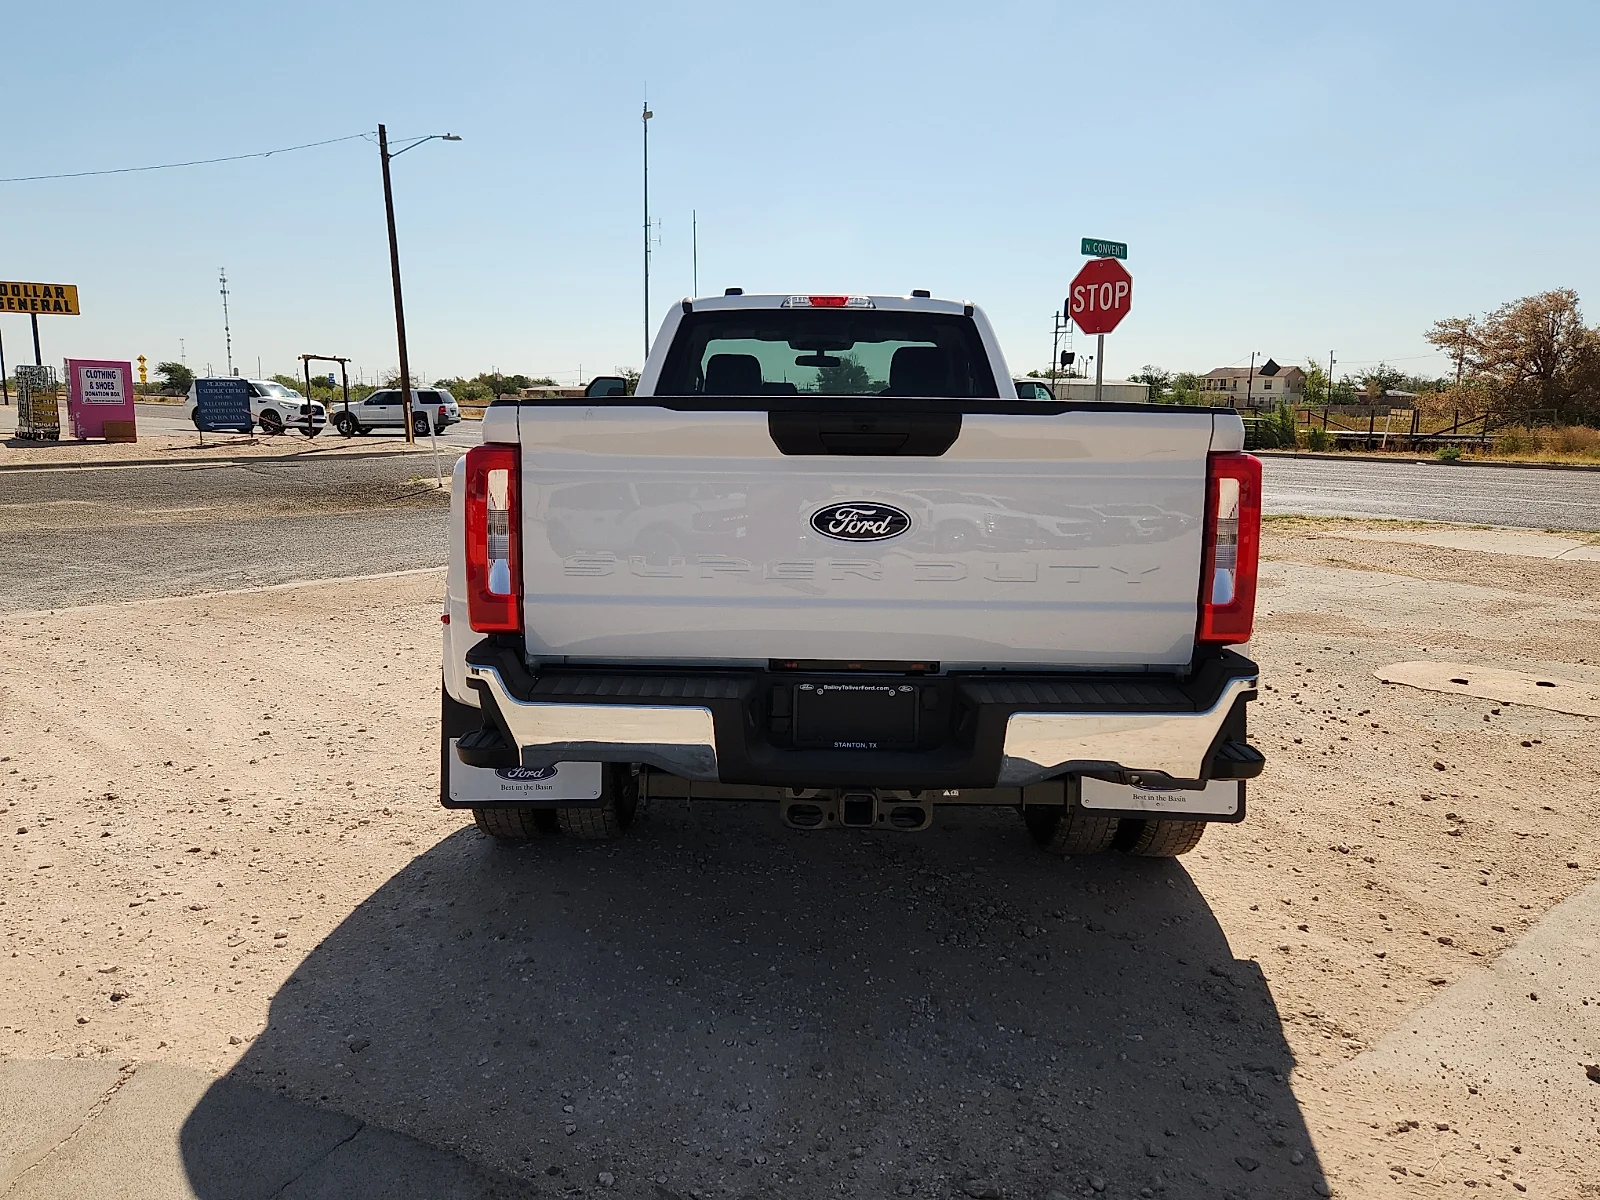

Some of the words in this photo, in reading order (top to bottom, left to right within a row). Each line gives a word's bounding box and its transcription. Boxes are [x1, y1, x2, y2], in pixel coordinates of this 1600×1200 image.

[1085, 244, 1091, 252] N
[1093, 243, 1123, 256] CONVENT
[0, 284, 65, 299] DOLLAR
[1072, 281, 1129, 313] STOP
[86, 370, 116, 379] CLOTHING
[90, 381, 94, 389] &
[95, 381, 115, 390] SHOES
[828, 508, 893, 534] Ford
[563, 552, 883, 581] SUPER
[914, 560, 1161, 584] DUTY
[823, 684, 890, 692] BaileyToliverFord.com
[1132, 793, 1147, 801] Best
[1155, 794, 1167, 802] the
[1168, 795, 1186, 803] Basin
